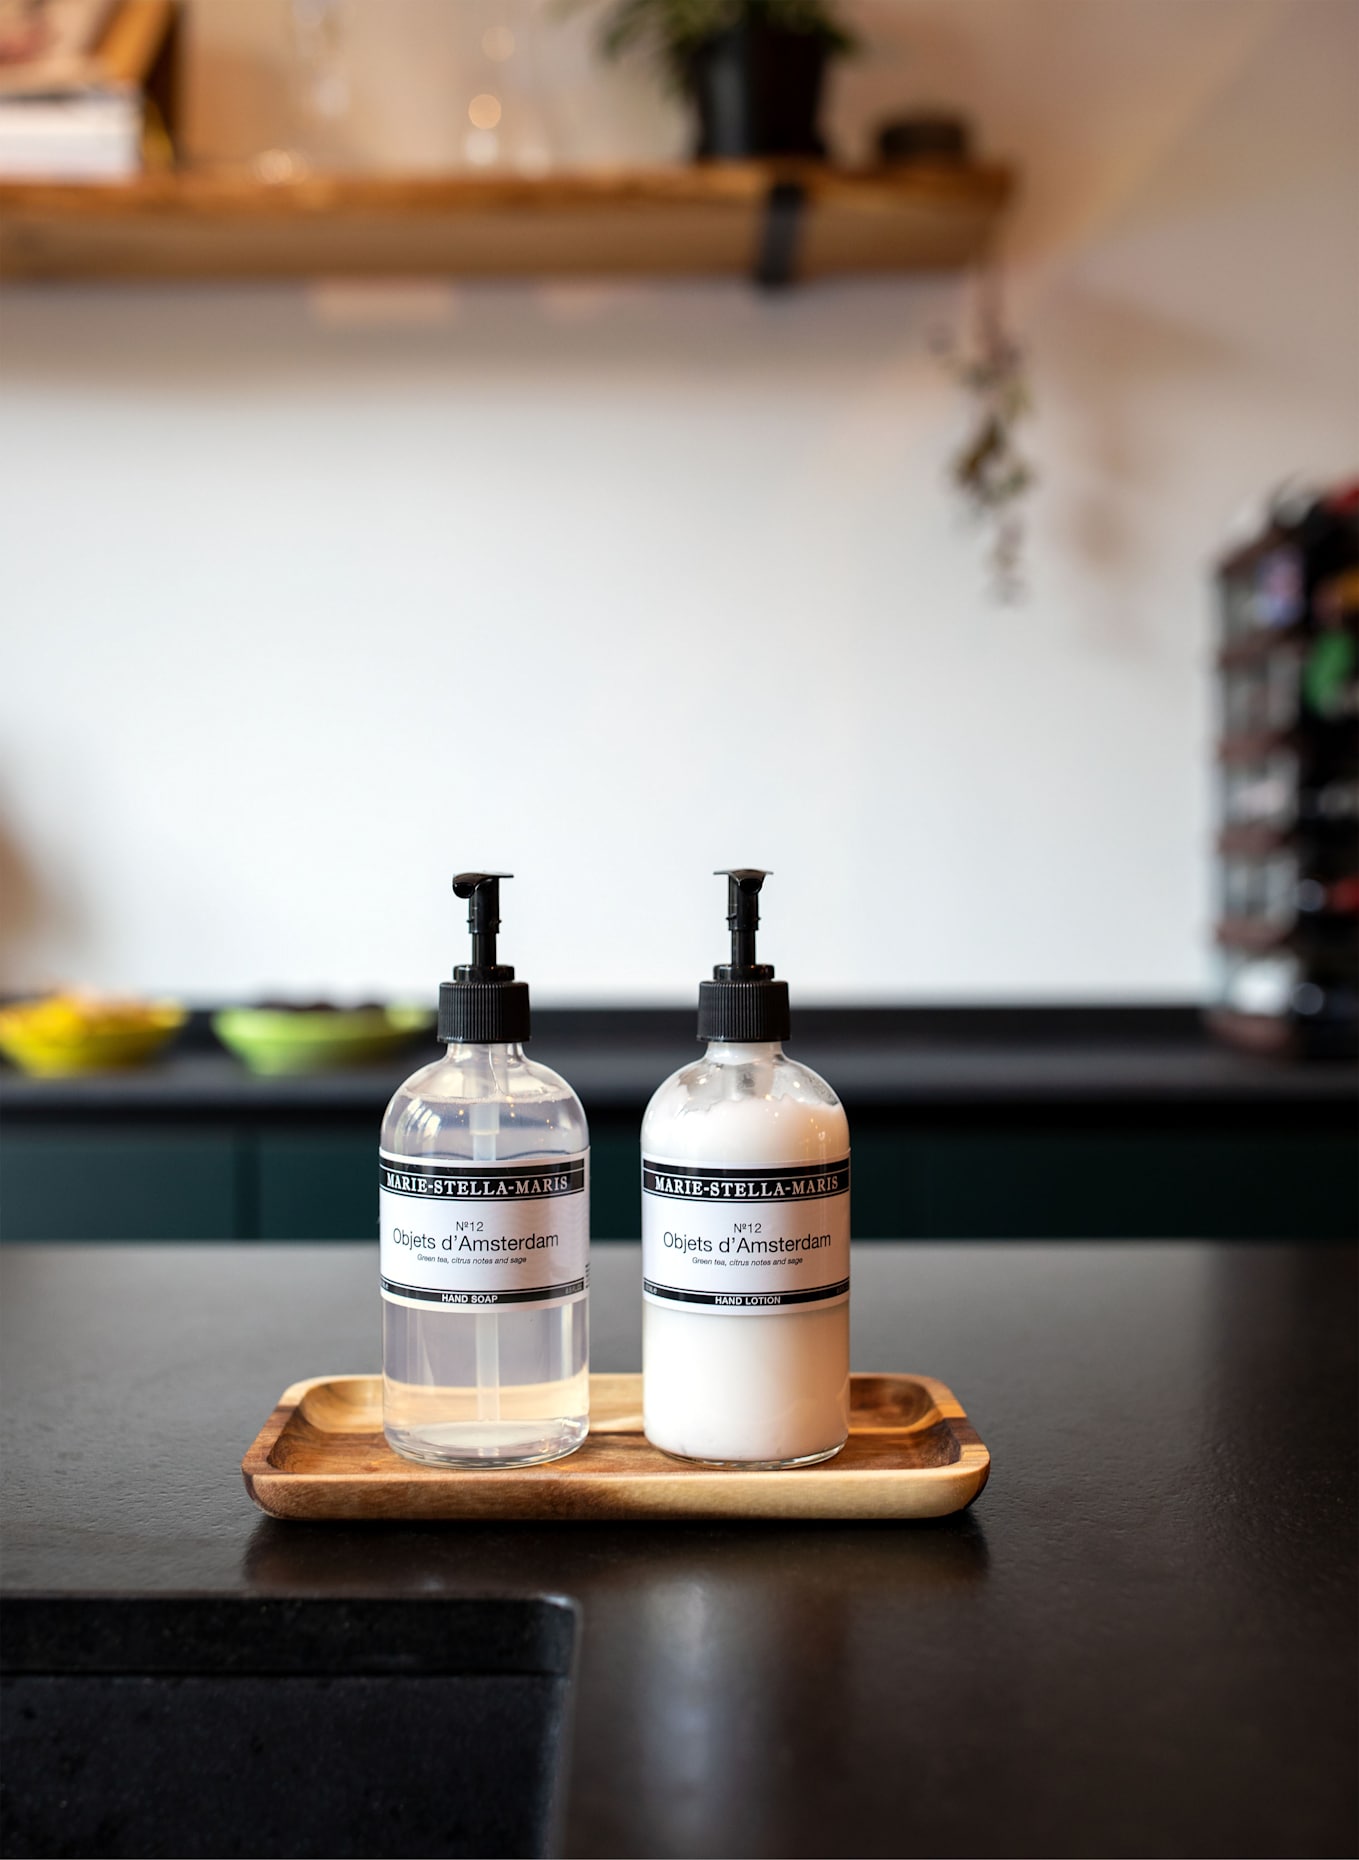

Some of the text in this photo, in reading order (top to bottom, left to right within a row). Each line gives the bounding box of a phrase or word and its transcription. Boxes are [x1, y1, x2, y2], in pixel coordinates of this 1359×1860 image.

[387, 1172, 568, 1195] MARIE-STELLA-MARIS
[655, 1175, 838, 1197] MARIE-STELLA-MARIS
[393, 1228, 435, 1250] Objets
[663, 1232, 712, 1253] Objets
[417, 1254, 435, 1262] Green
[437, 1256, 449, 1264] tea,
[510, 1256, 526, 1264] sage
[692, 1257, 712, 1265] Green
[714, 1259, 726, 1267] tea,
[729, 1258, 749, 1266] citrus
[442, 1294, 498, 1303] HAND SOAP
[715, 1296, 780, 1305] HAND LOTION
